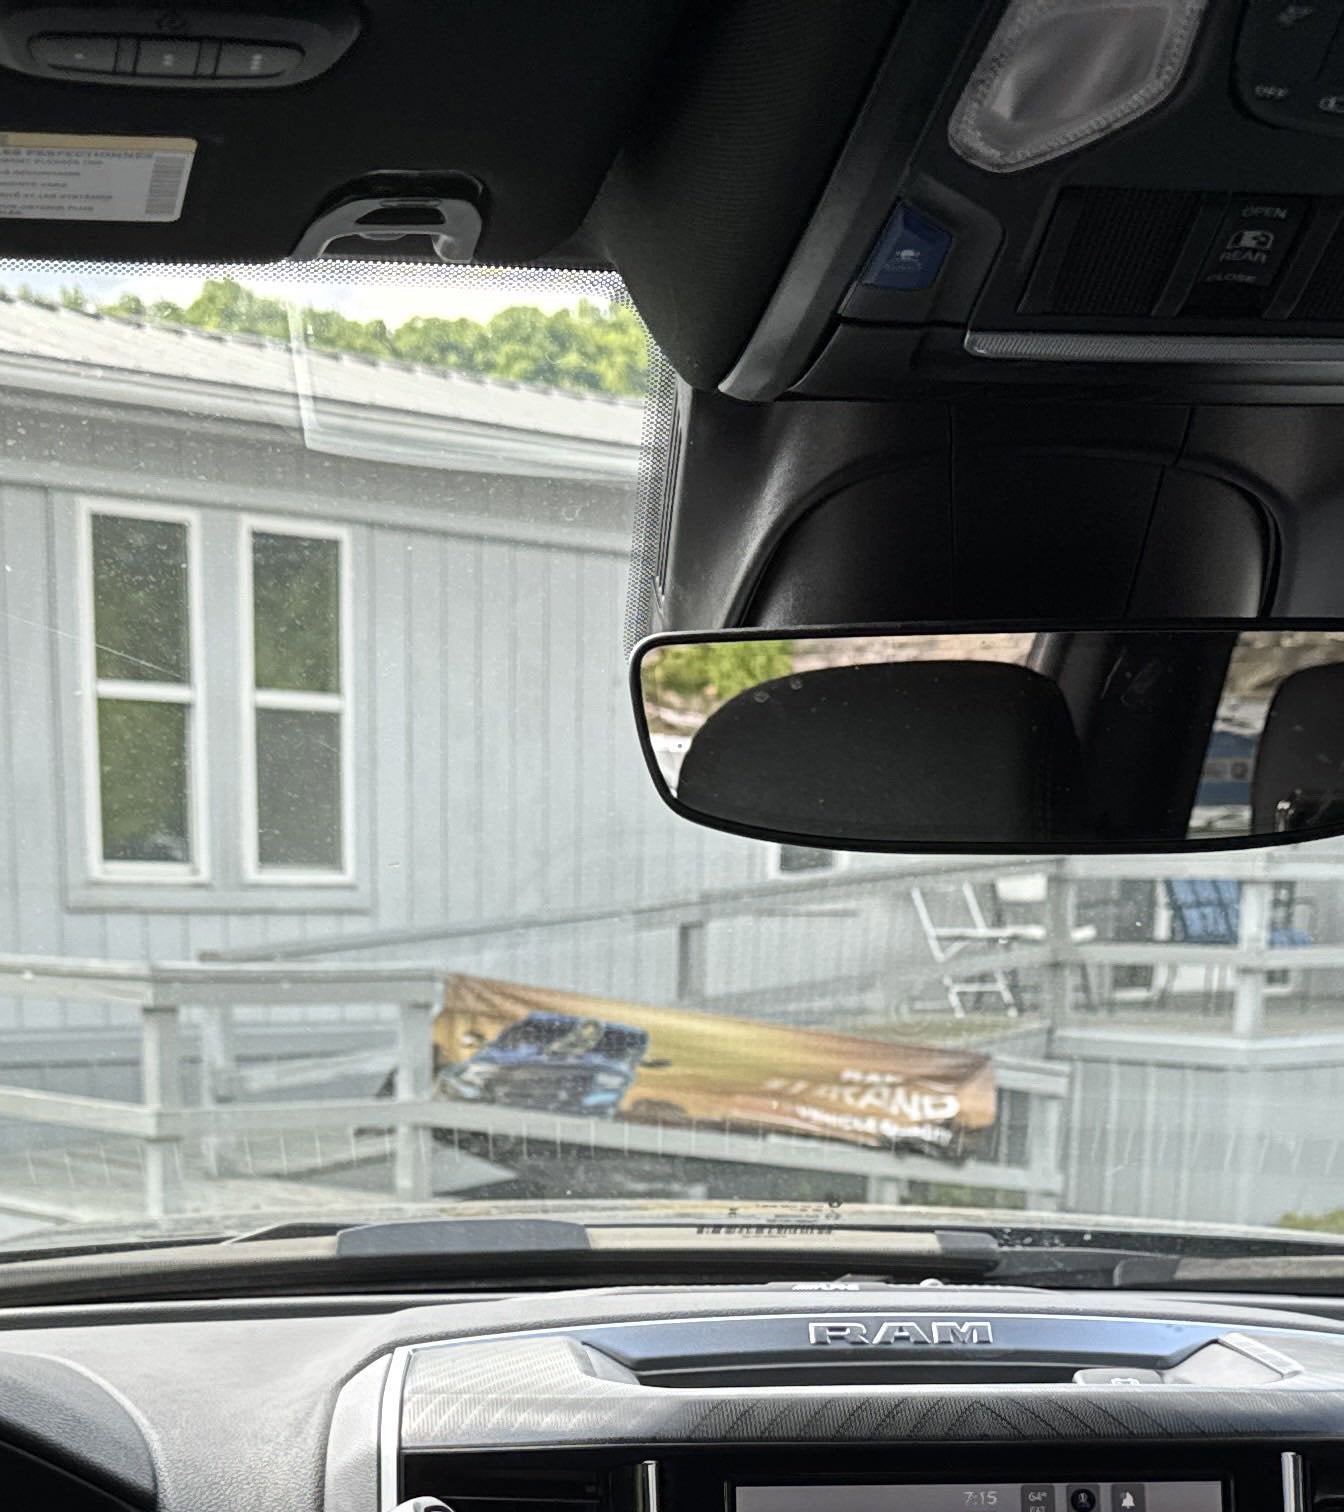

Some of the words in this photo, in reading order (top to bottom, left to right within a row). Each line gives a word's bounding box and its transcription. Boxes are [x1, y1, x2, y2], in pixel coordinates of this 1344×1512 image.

[1242, 206, 1288, 221] OPEN
[1219, 248, 1267, 264] REAR
[1206, 271, 1257, 285] CLOSE
[808, 1321, 994, 1345] RAM
